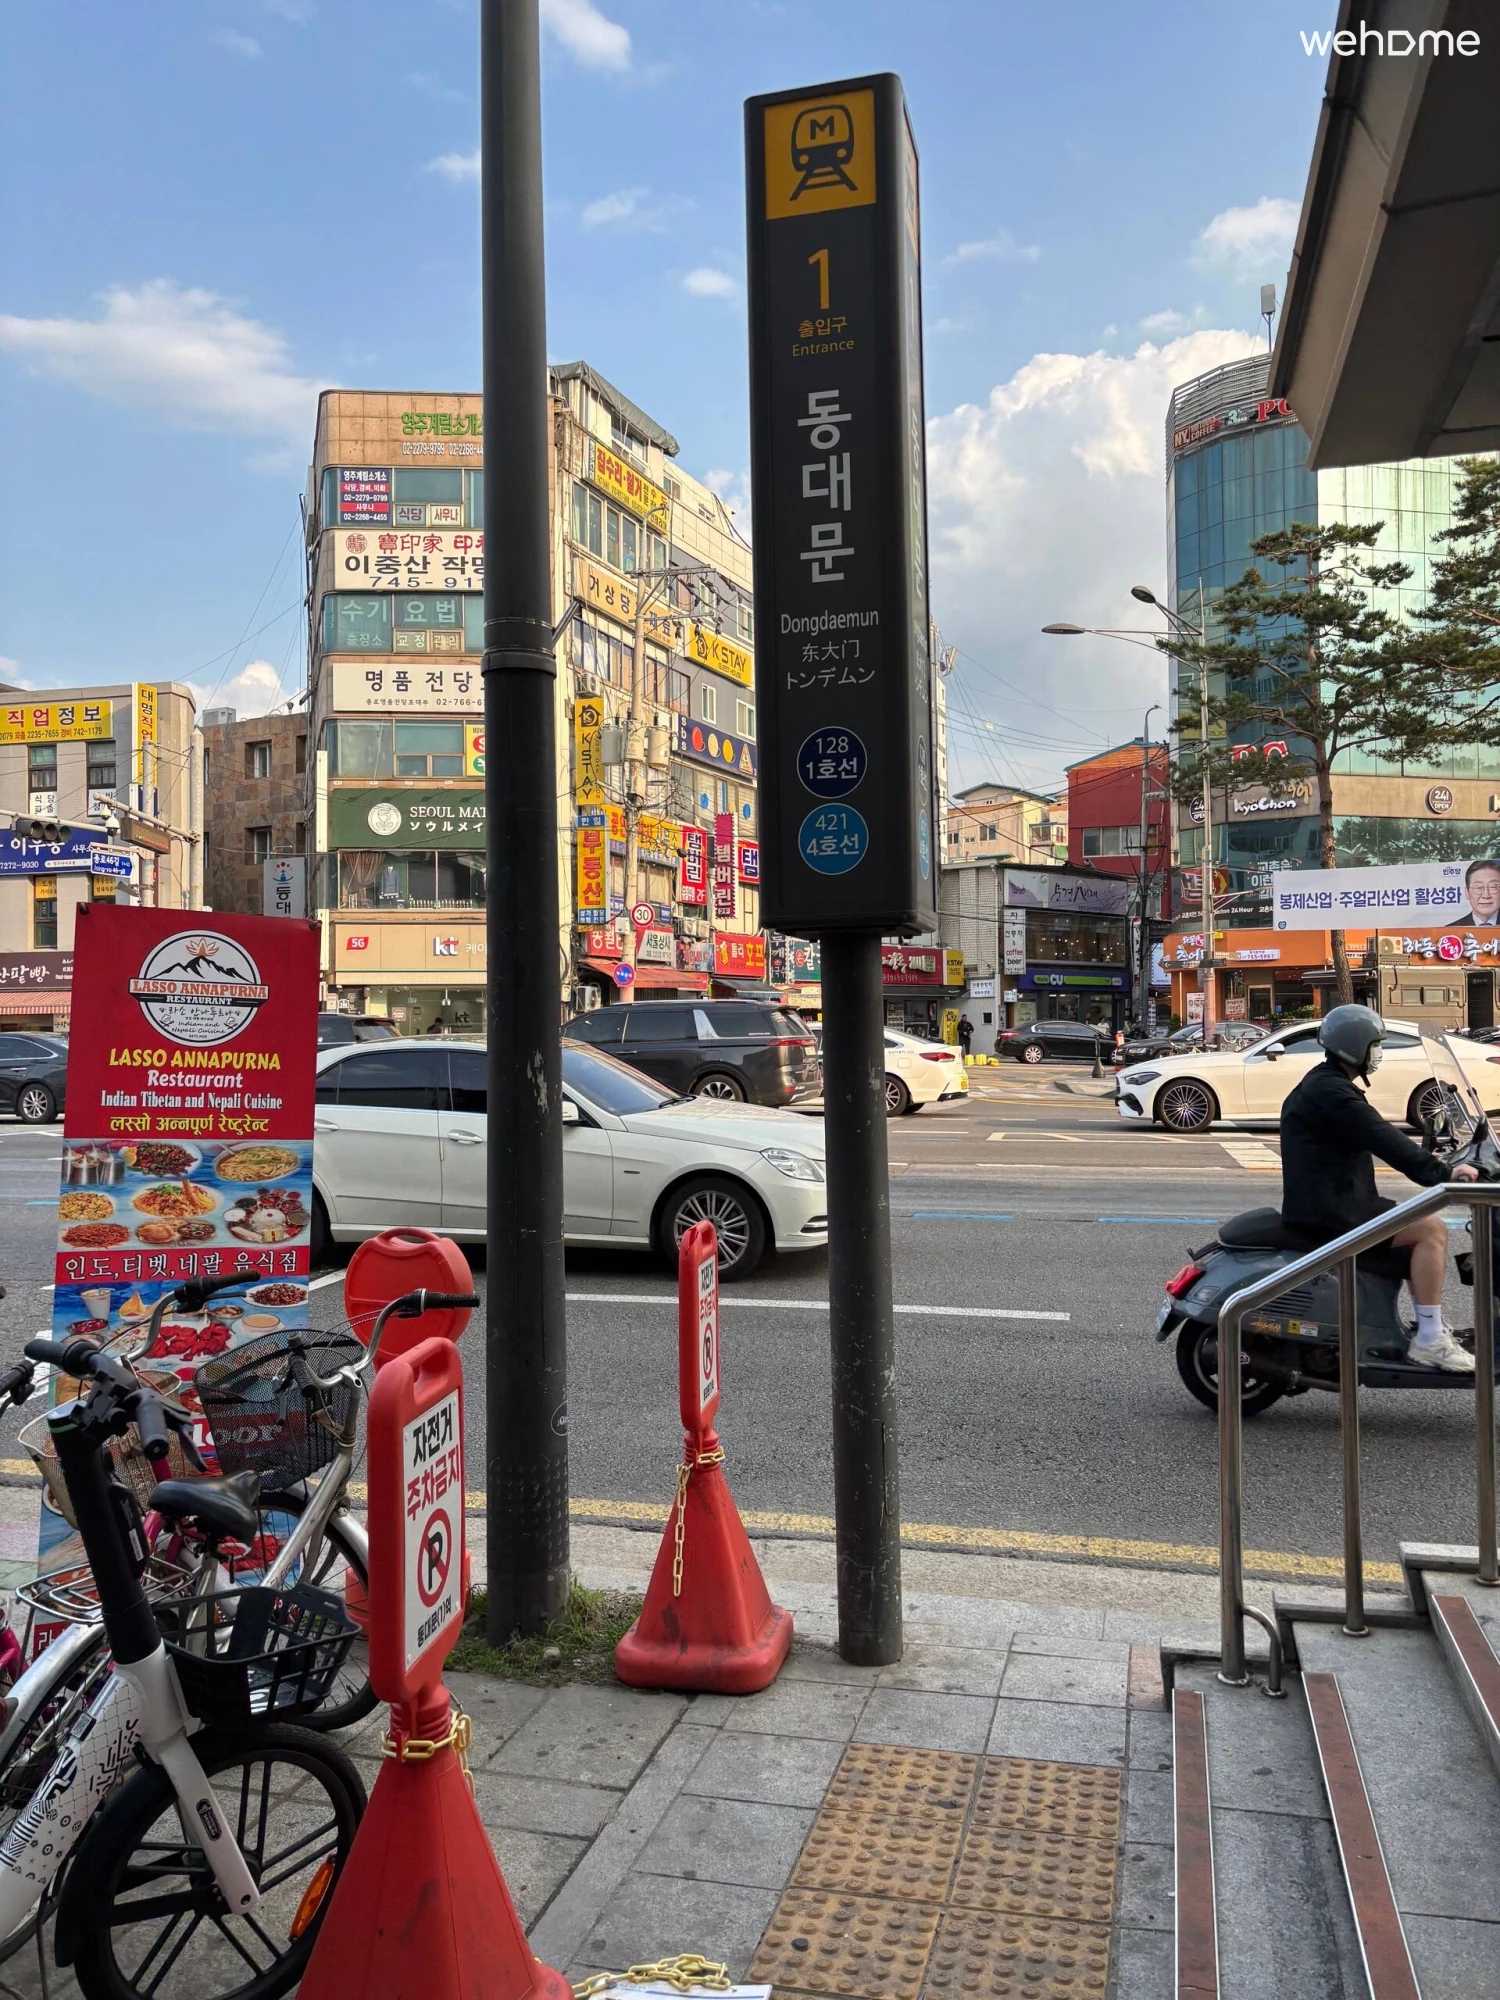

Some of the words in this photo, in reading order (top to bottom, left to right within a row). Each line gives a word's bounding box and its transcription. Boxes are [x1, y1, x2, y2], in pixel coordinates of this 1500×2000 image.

[807, 248, 830, 311] 1
[797, 316, 848, 339] 출입구
[791, 339, 855, 357] Entrance
[1190, 424, 1214, 441] COFFEE
[797, 389, 855, 584] 동대문
[398, 507, 423, 521] 식당
[344, 555, 431, 575] 이중산
[780, 609, 880, 637] Dongdaemun
[801, 638, 860, 663] 东大门
[425, 670, 484, 694] 전당
[786, 666, 876, 691] トンデムン
[680, 716, 688, 751] sbs
[815, 736, 850, 755] 128
[805, 756, 858, 780] 1호선
[409, 806, 455, 818] SEOUL
[1434, 802, 1450, 810] OPEN
[815, 812, 847, 831] 421
[805, 833, 860, 857] 4호선
[93, 854, 120, 867] 종로46길
[582, 830, 603, 906] 부동산
[1414, 886, 1463, 906] 활성화
[636, 909, 650, 921] 30
[351, 938, 365, 948] 5G
[434, 936, 459, 956] kt
[1005, 948, 1023, 956] coffee
[1403, 936, 1437, 958] 하동
[745, 941, 764, 967] 호프
[1007, 957, 1022, 965] beer
[132, 980, 178, 994] LASSO
[180, 983, 268, 998] ANNAPURNA
[1050, 974, 1064, 986] CU
[166, 995, 233, 1006] RESTAURANT
[454, 1011, 471, 1024] kt
[109, 1048, 167, 1068] LASSO
[170, 1050, 281, 1071] ANNAPURNA
[147, 1069, 244, 1089] Restaurant
[100, 1089, 138, 1108] Indian
[140, 1090, 182, 1109] Tibetan
[184, 1091, 205, 1109] and
[206, 1092, 241, 1113] Nepali
[243, 1093, 283, 1110] Cuisine
[110, 1112, 152, 1132] लस्सो
[155, 1114, 215, 1136] अन्नपूर्ण
[232, 1250, 298, 1275] 음식점
[411, 1401, 454, 1468] 자전거
[405, 1443, 460, 1522] 주차금지
[417, 1593, 453, 1649] 동대문(1)역
